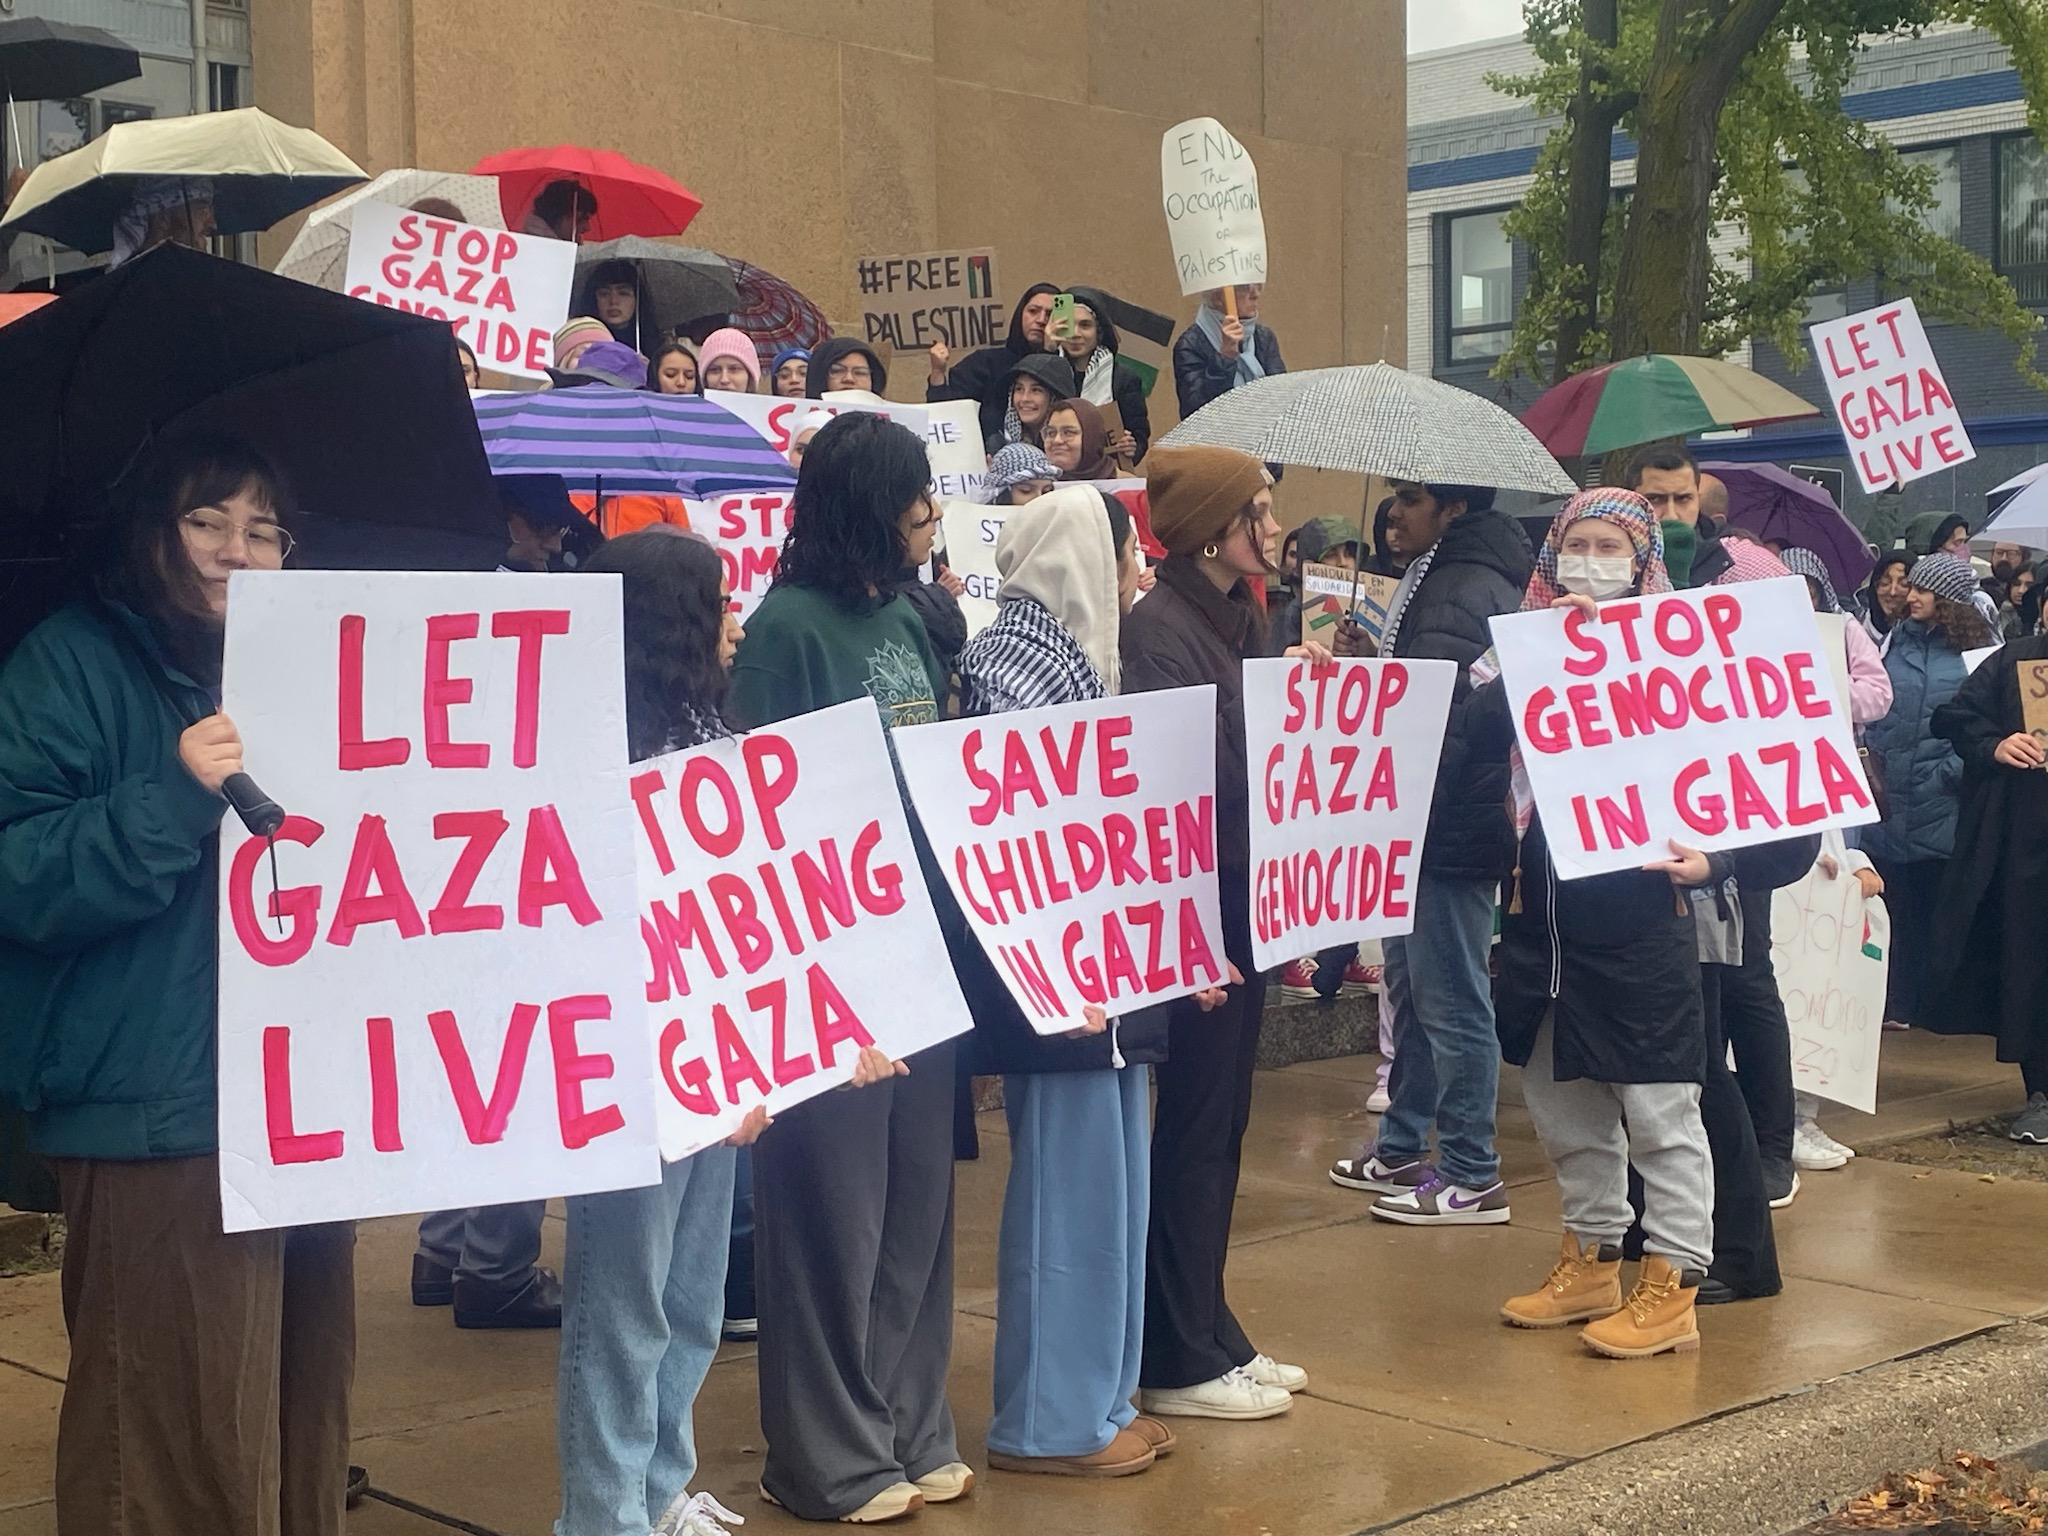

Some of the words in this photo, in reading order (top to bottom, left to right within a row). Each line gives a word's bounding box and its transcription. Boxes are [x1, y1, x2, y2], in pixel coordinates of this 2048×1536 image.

[381, 253, 516, 313] GAZA
[392, 215, 518, 274] STOP
[858, 256, 961, 294] #FREE
[864, 304, 1007, 350] PALESTINE
[1825, 309, 1906, 378] LET
[928, 422, 956, 444] HE
[1840, 368, 1953, 439] GAZA
[1860, 425, 1964, 484] LIVE
[1307, 566, 1366, 584] HONDURS
[1371, 576, 1385, 588] EN
[1307, 577, 1363, 595] SOLIDARIDD
[1564, 594, 1742, 676] STOP
[338, 610, 571, 772] LET
[1284, 661, 1408, 737] STOP
[1524, 653, 1832, 754] GENOCIDE
[630, 734, 798, 875] TOP
[962, 716, 1139, 825] SAVE
[1265, 743, 1398, 825] GAZA
[1571, 784, 1650, 851] IN
[1673, 736, 1871, 836] GAZA
[228, 804, 603, 967] GAZA
[955, 795, 1214, 925] CHILDREN
[1256, 840, 1412, 943] GENOCIDE
[998, 939, 1069, 1017] IN
[1062, 897, 1221, 1004] GAZA
[263, 995, 626, 1165] LIVE
[659, 962, 876, 1116] GAZA
